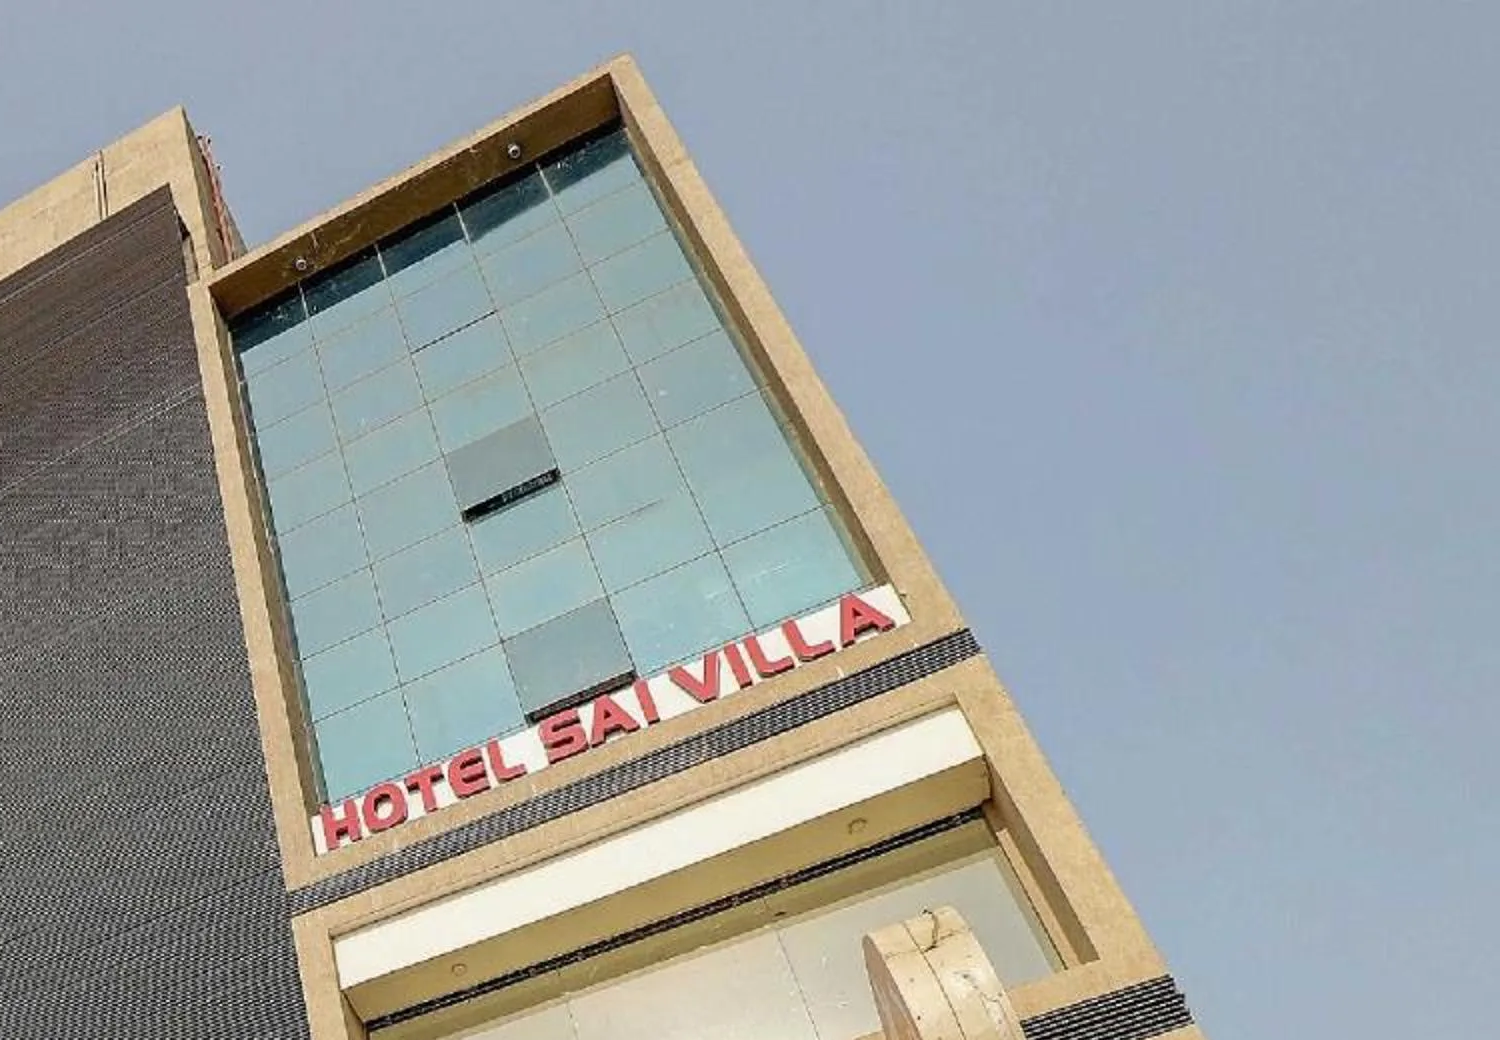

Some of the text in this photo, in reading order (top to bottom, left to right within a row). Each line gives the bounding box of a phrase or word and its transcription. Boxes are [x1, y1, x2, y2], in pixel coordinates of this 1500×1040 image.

[321, 593, 896, 851] HOTEL SAI VILLA
